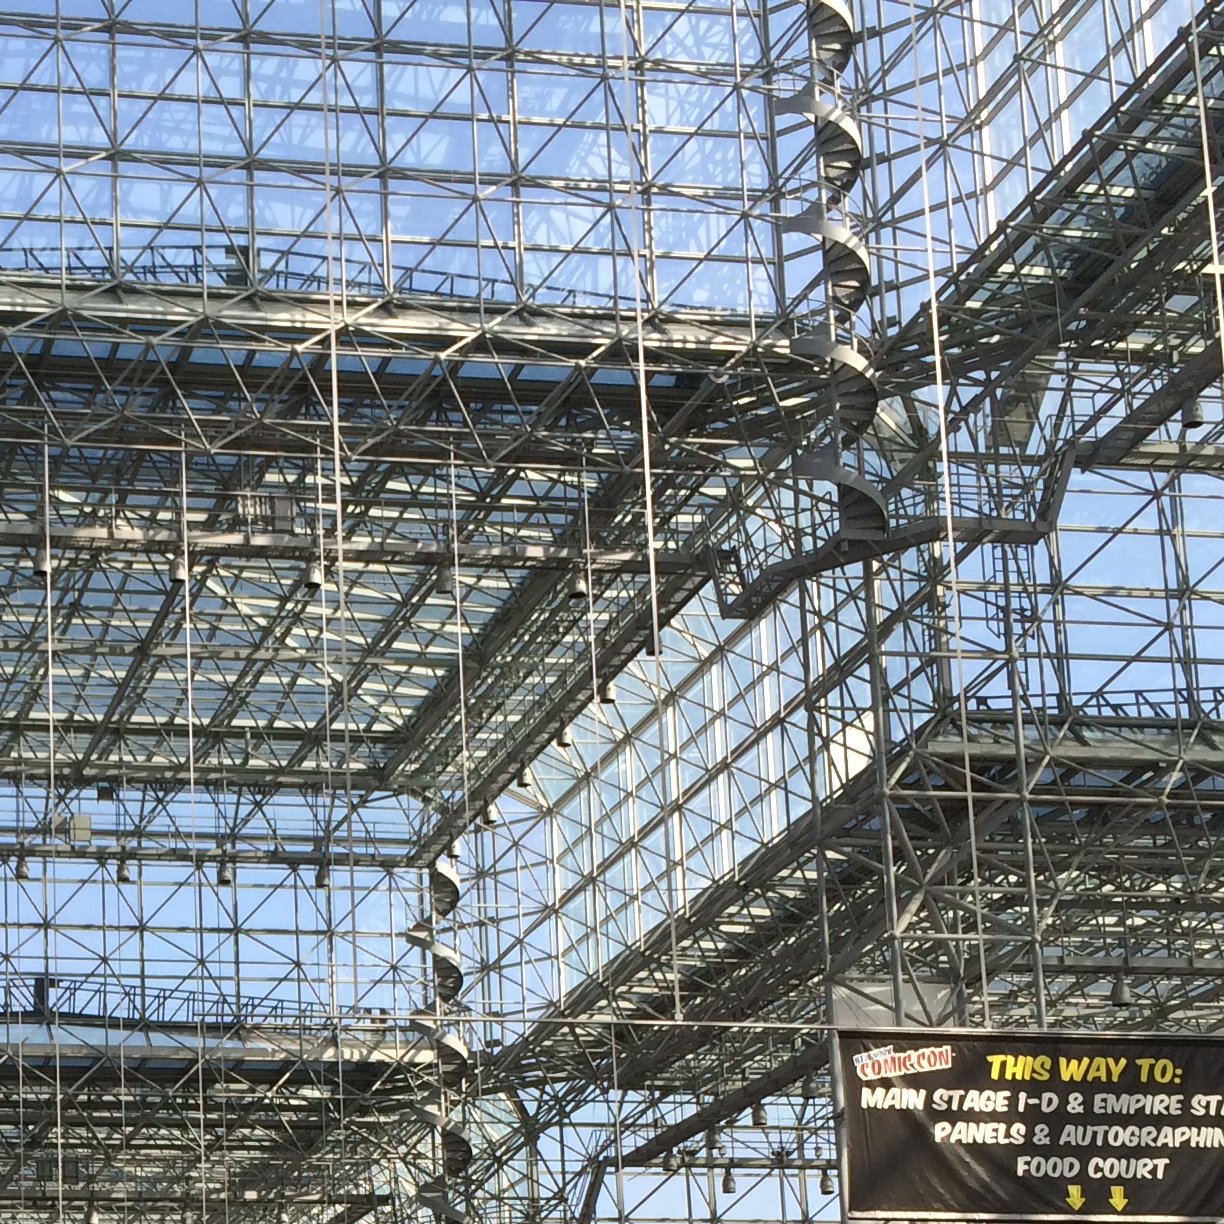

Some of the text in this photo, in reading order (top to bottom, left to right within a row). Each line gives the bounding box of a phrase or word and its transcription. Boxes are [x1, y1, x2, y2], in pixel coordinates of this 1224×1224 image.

[860, 1049, 949, 1077] COMIC CON
[986, 1055, 1183, 1084] THIS WAY TO:
[861, 1087, 1224, 1116] MAIN STAGE 1-D & EMPIRE ST
[934, 1122, 1026, 1145] PANELS
[1033, 1124, 1051, 1145] &
[1017, 1156, 1170, 1180] FOOD COURT
